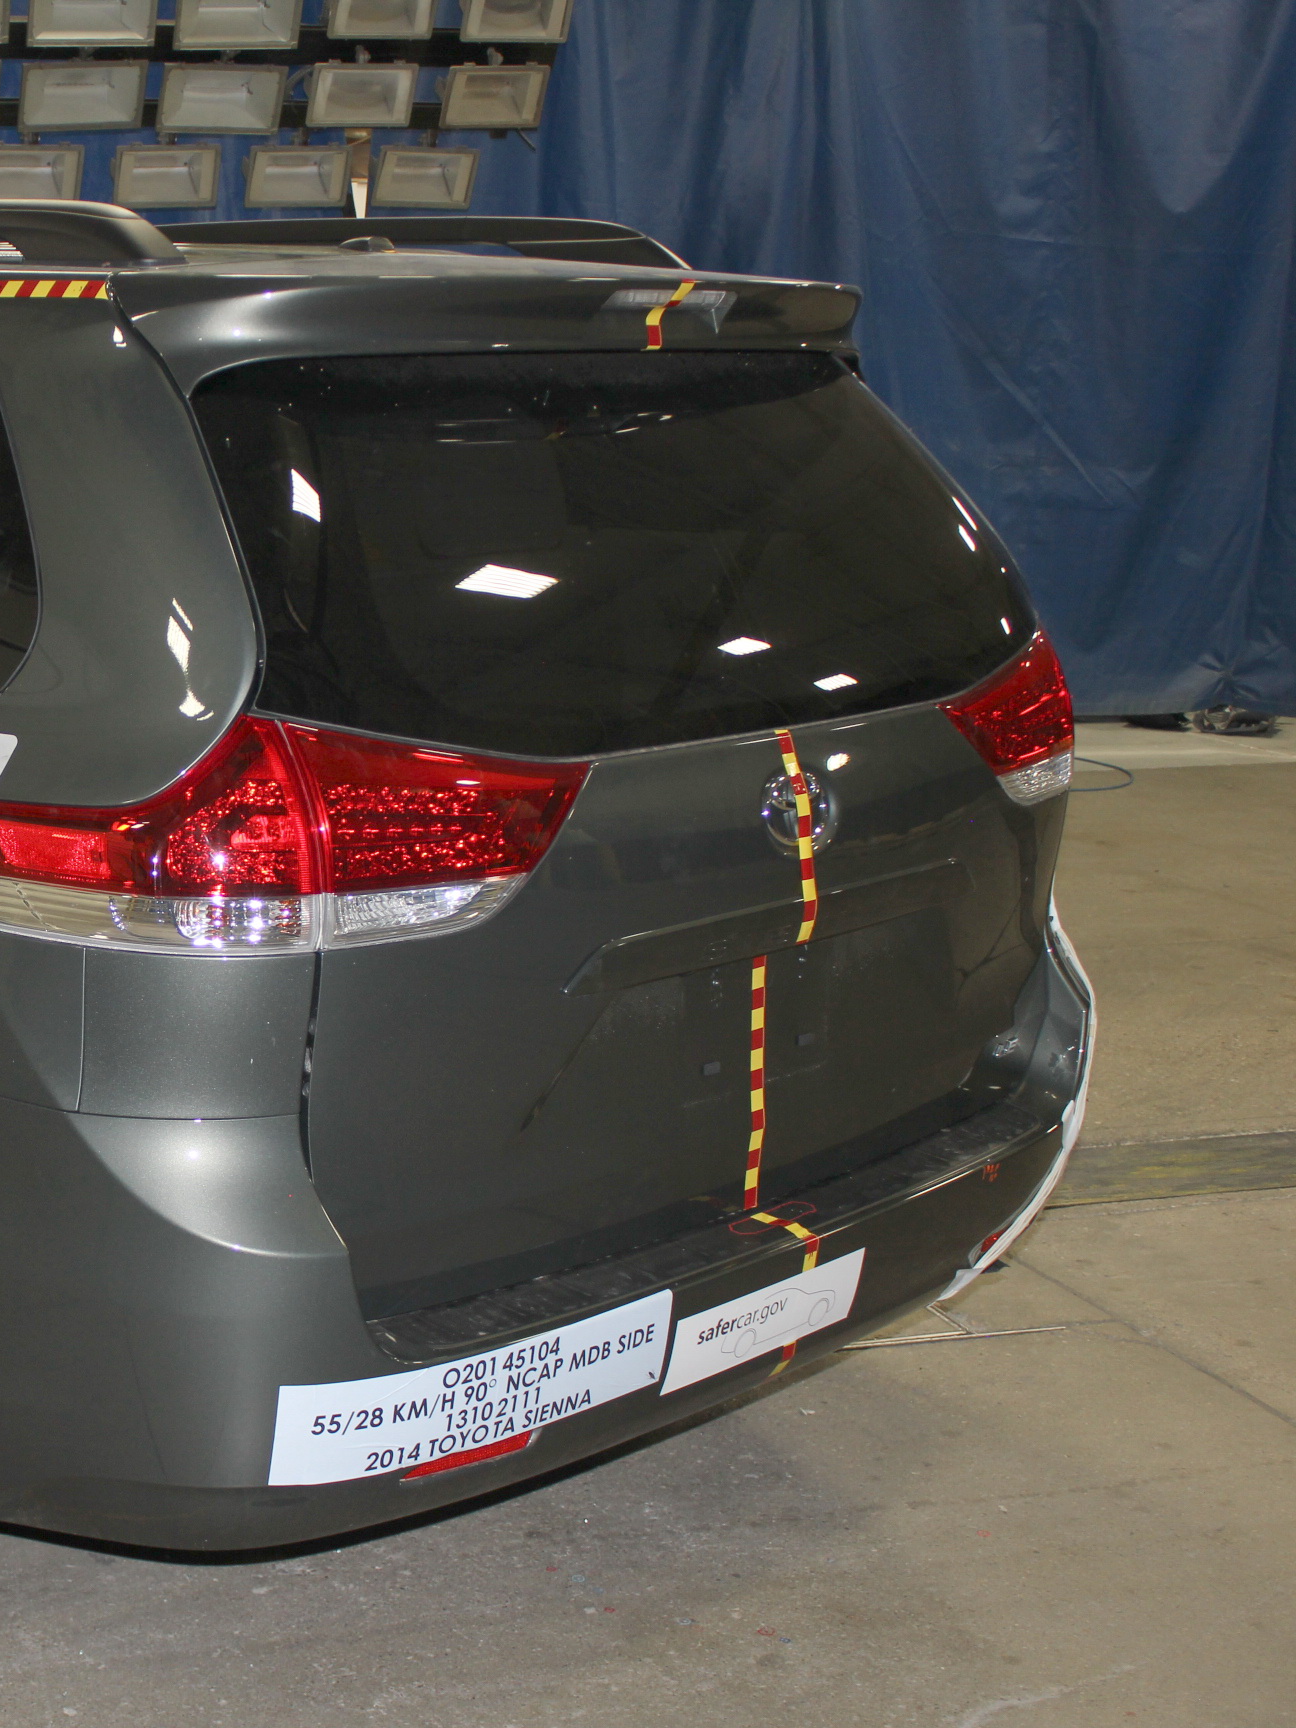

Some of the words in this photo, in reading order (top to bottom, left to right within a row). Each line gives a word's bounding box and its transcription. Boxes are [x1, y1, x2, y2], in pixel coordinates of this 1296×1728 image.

[697, 1297, 788, 1345] safercar.gov
[311, 1407, 384, 1436] 55/28
[392, 1391, 456, 1424] KM/H
[506, 1358, 564, 1394] NCAP
[568, 1341, 611, 1373] MDB
[616, 1323, 656, 1354] SIDE
[446, 1386, 542, 1432] 13102111
[364, 1443, 421, 1472] 2014
[429, 1417, 515, 1457] TOYOTA
[522, 1389, 592, 1429] SIENNA
